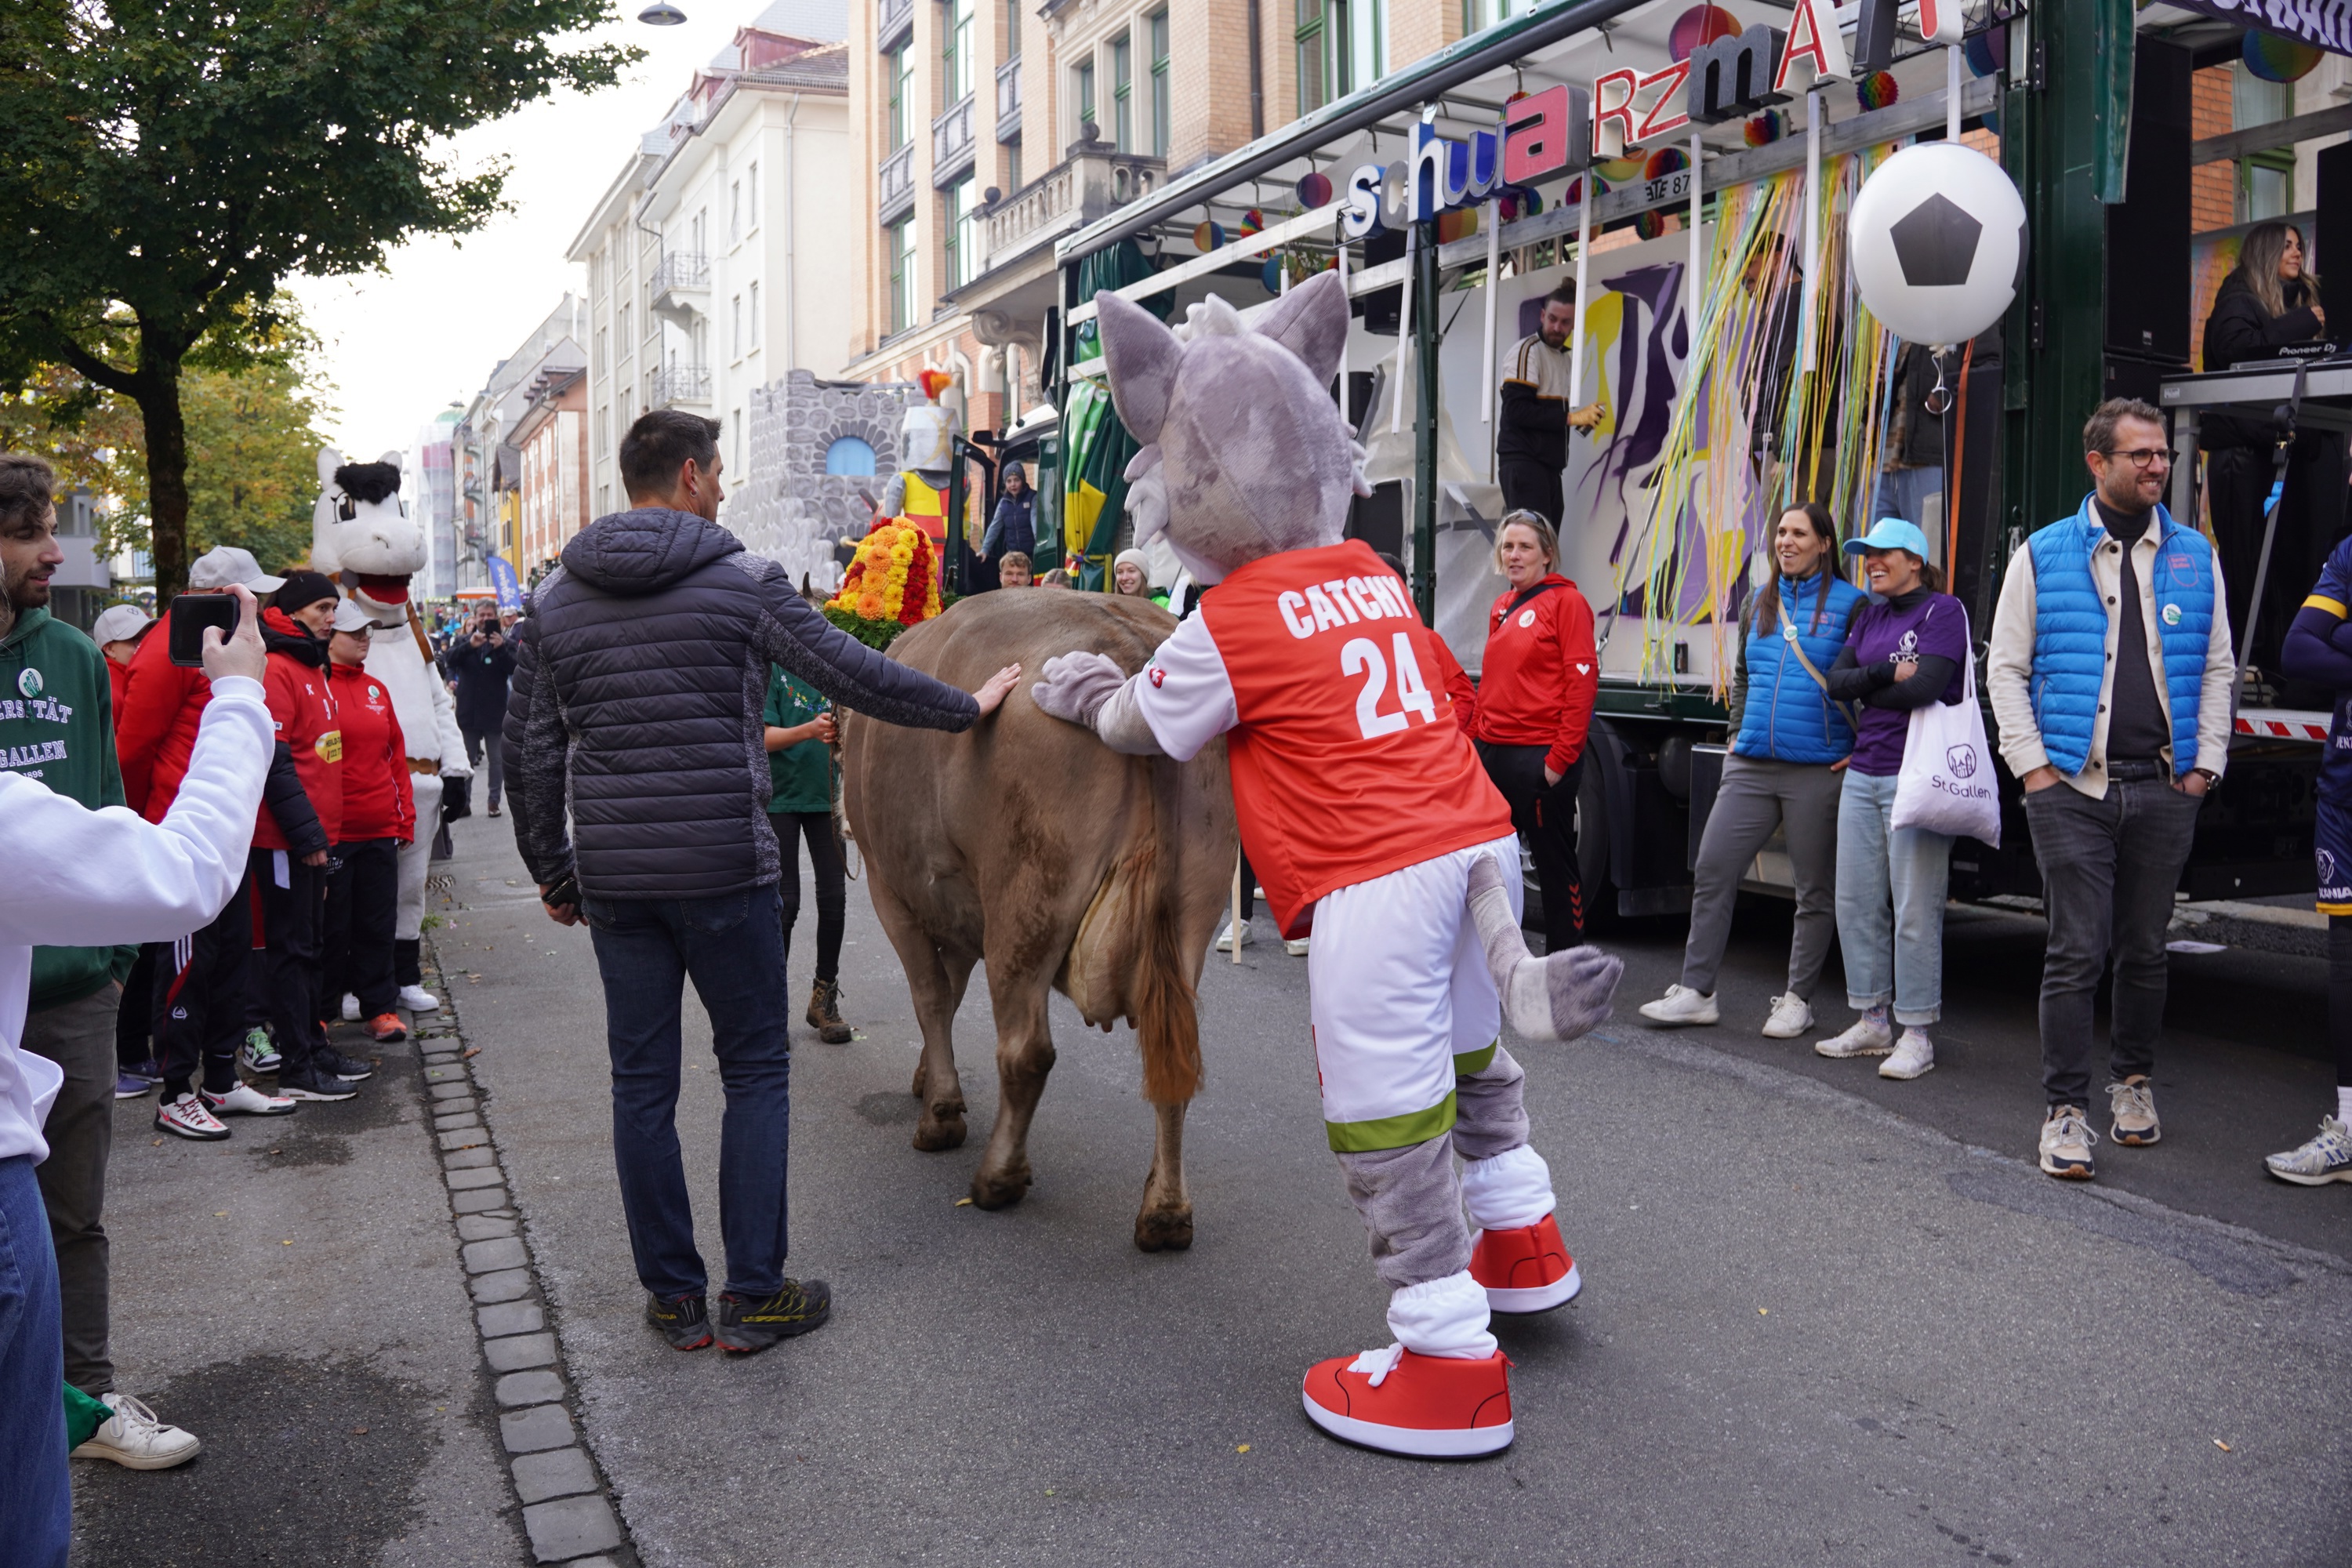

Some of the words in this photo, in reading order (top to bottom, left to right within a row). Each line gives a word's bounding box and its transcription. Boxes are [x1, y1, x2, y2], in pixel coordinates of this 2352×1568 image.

[2278, 346, 2322, 356] Pioneer
[1277, 575, 1414, 640] CATCHY
[0, 695, 73, 724] RSTÄT
[1340, 632, 1438, 740] 24
